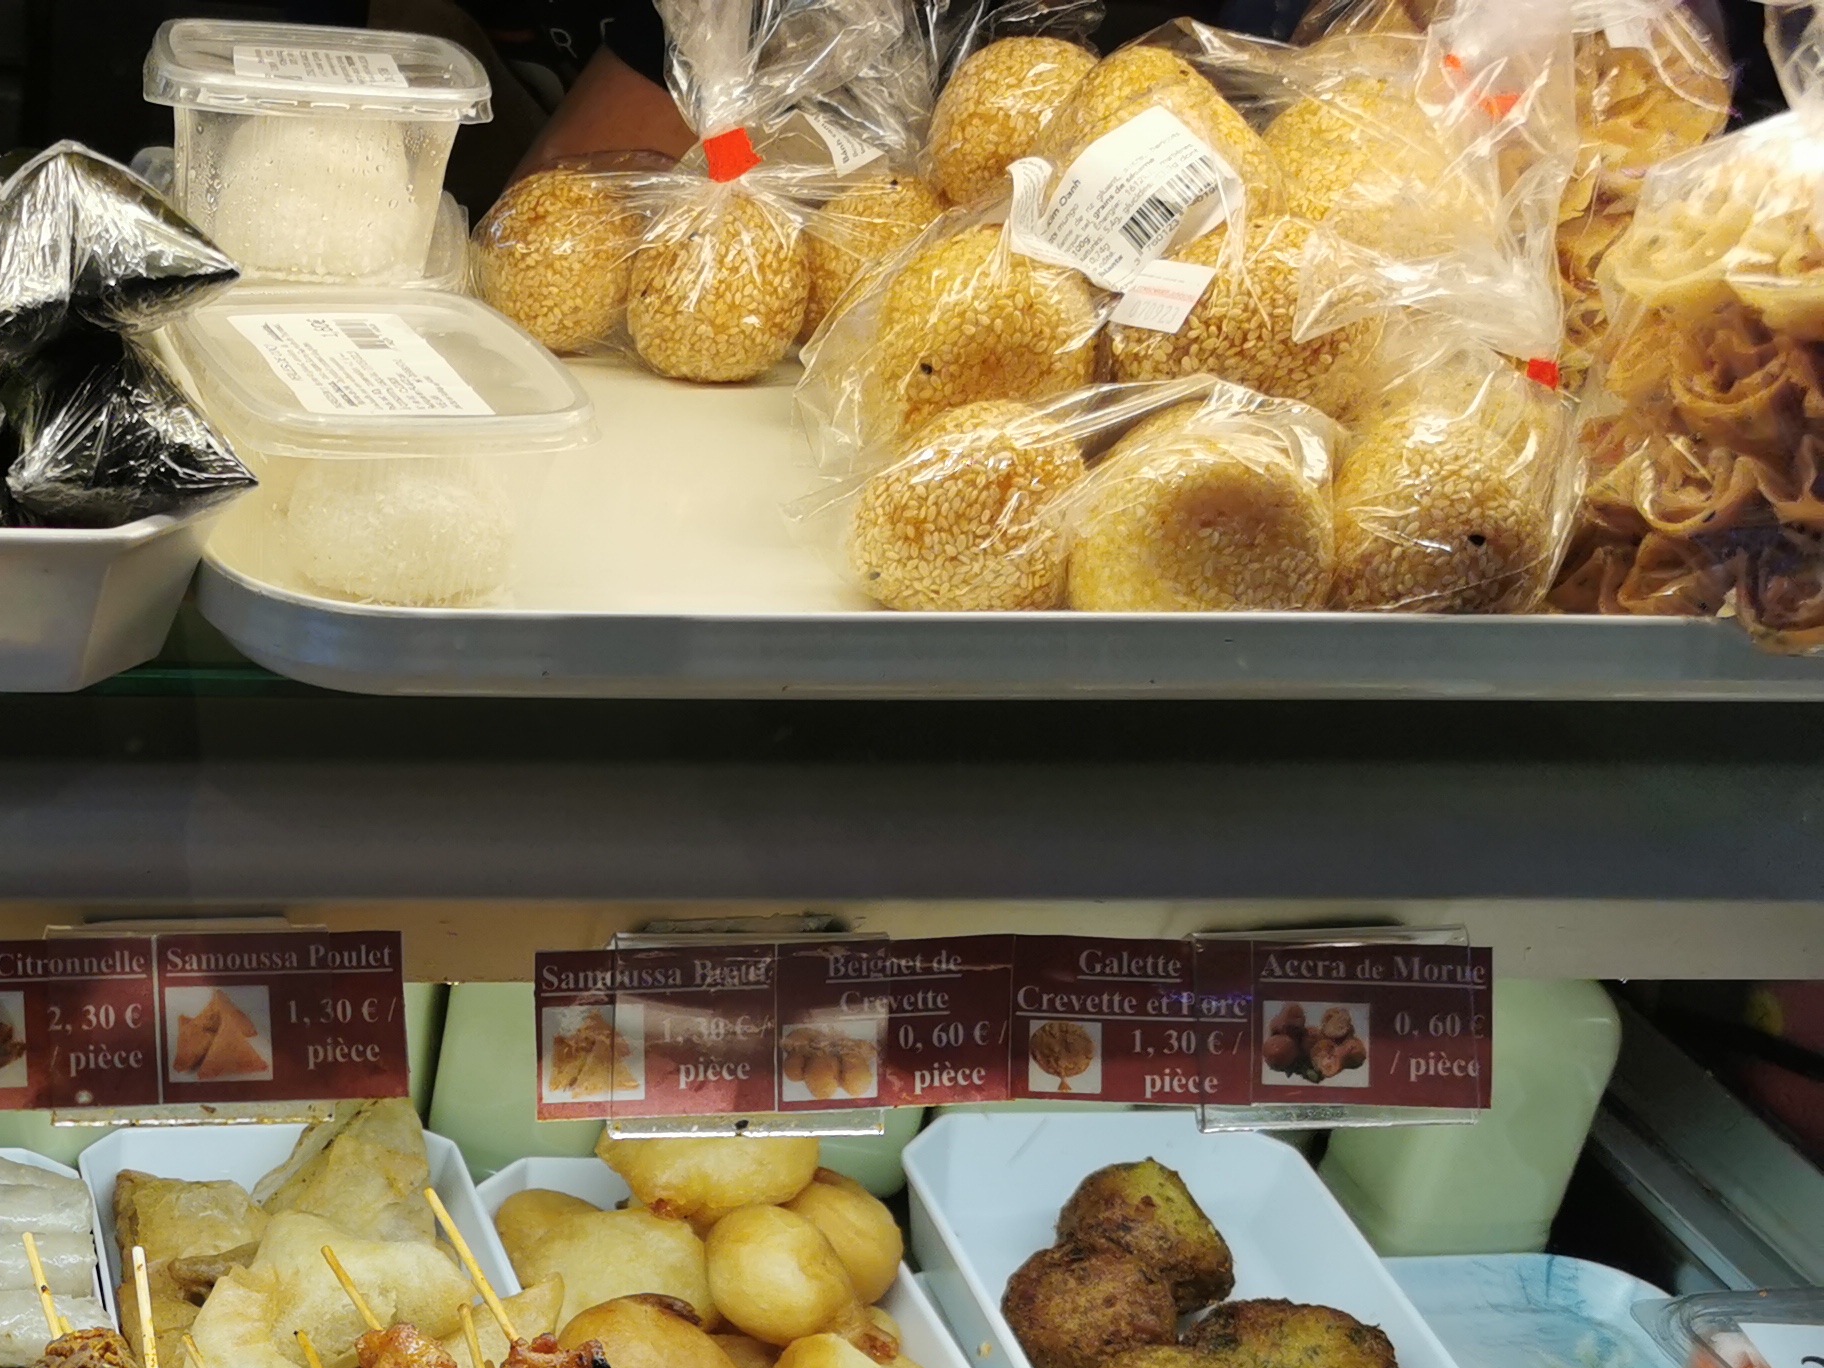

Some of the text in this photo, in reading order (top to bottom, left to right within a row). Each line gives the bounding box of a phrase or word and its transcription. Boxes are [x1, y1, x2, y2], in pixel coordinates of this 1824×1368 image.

[166, 944, 392, 973] Samoussa Poulet
[828, 950, 963, 980] Beignet de
[1078, 949, 1183, 978] Galette
[1260, 954, 1486, 984] Accra de Morue
[542, 965, 682, 990] Samoussa
[840, 988, 950, 1015] Crevette
[1016, 986, 1248, 1018] Crevette et Porc
[69, 1045, 143, 1077] pièce
[307, 1037, 380, 1071] pièce
[1409, 1051, 1481, 1082] pièce
[679, 1056, 751, 1090] pièce
[914, 1064, 987, 1095] pièce
[1144, 1068, 1220, 1099] pièce
